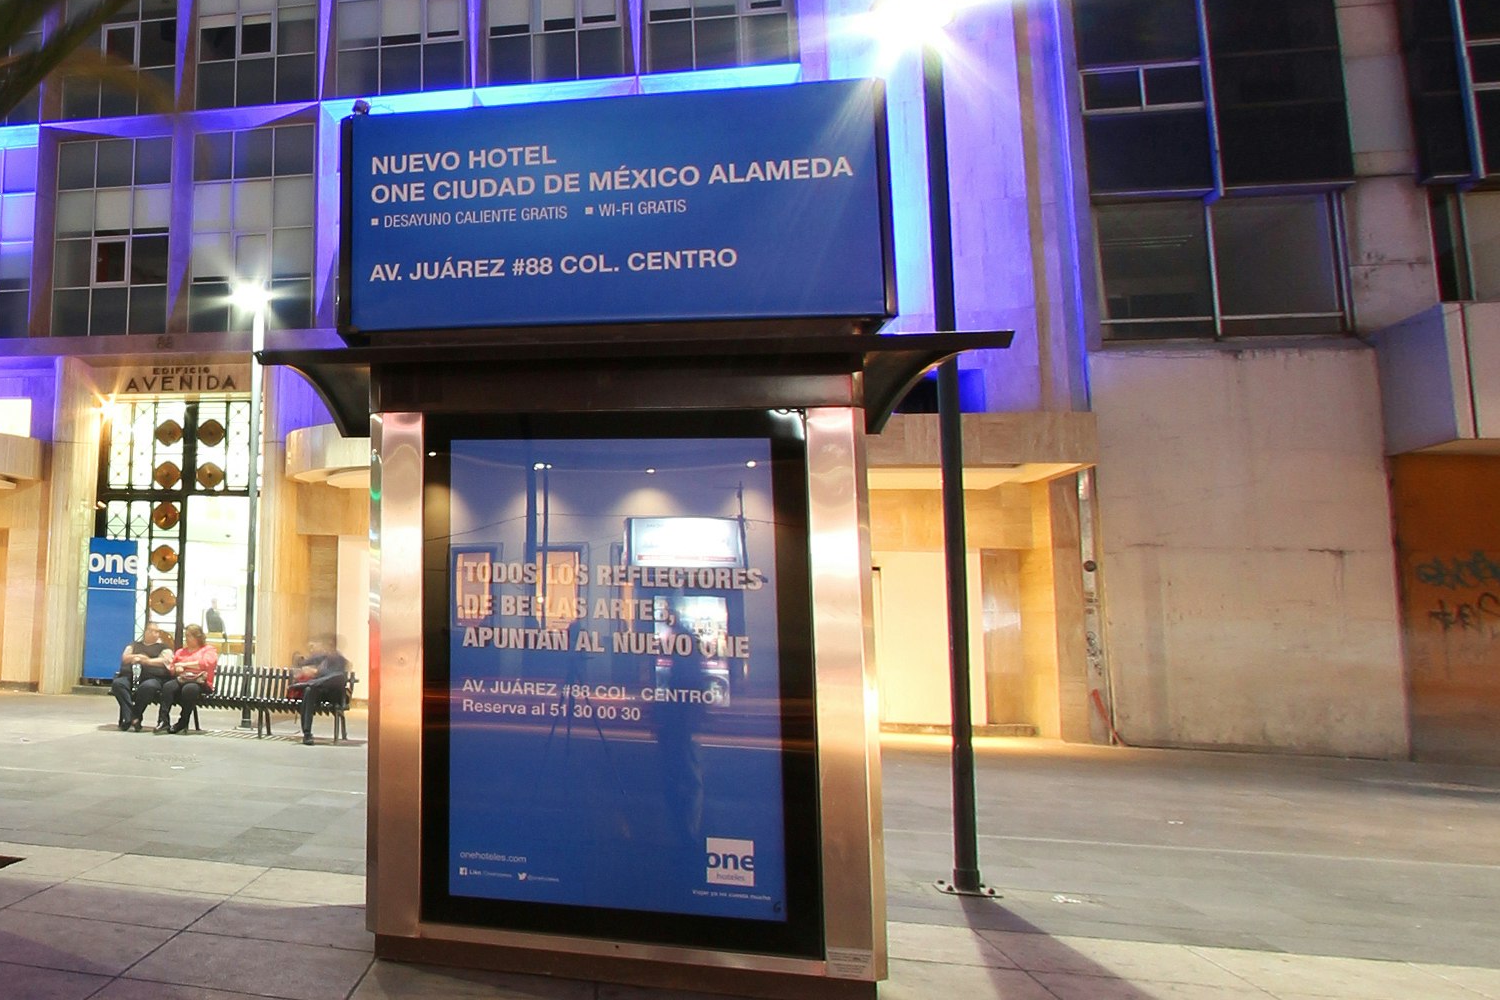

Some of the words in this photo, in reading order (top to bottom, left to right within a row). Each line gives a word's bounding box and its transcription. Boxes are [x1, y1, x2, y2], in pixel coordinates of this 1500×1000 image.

[371, 151, 460, 175] NUEVO
[468, 145, 556, 169] HOTEL
[371, 182, 425, 204] ONE
[433, 176, 535, 200] CIUDAD
[544, 173, 580, 194] DE
[589, 165, 700, 192] MÉXICO
[708, 156, 853, 185] ALAMEDA
[384, 212, 451, 228] DESAYUNO
[455, 208, 517, 225] CALIENTE
[521, 206, 568, 221] GRATIS
[599, 202, 633, 217] WI-FI
[638, 199, 687, 215] GRATIS
[370, 263, 402, 282] AV.
[409, 257, 505, 281] JUÁREZ
[512, 257, 553, 276] #88
[560, 254, 619, 274] COL.
[627, 248, 737, 272] CENTRO
[152, 366, 211, 376] EDIFICIO
[125, 375, 237, 393] AVENIDA
[89, 552, 138, 574] one
[98, 575, 130, 586] hoteles
[463, 562, 535, 584] TODOS
[546, 564, 589, 585] LOS
[596, 565, 763, 591] REFLECTORES
[464, 594, 493, 616] DE
[501, 595, 588, 618] BELLAS
[462, 627, 569, 651] APUNTAN
[575, 631, 605, 652] AL
[613, 631, 692, 656] NUEVO
[699, 635, 750, 659] ONE
[462, 679, 485, 693] AV.
[490, 678, 557, 696] JUÁREZ
[563, 684, 590, 698] #88
[595, 685, 636, 701] COL.
[641, 688, 714, 704] CENTRO
[462, 699, 526, 715] Reserva
[531, 702, 545, 716] al
[550, 703, 567, 717] 51
[573, 704, 592, 718] 30
[597, 705, 616, 720] 00
[621, 707, 641, 721] 30
[460, 851, 527, 864] onehoteles.com
[706, 852, 754, 871] one
[716, 873, 746, 881] hoteles
